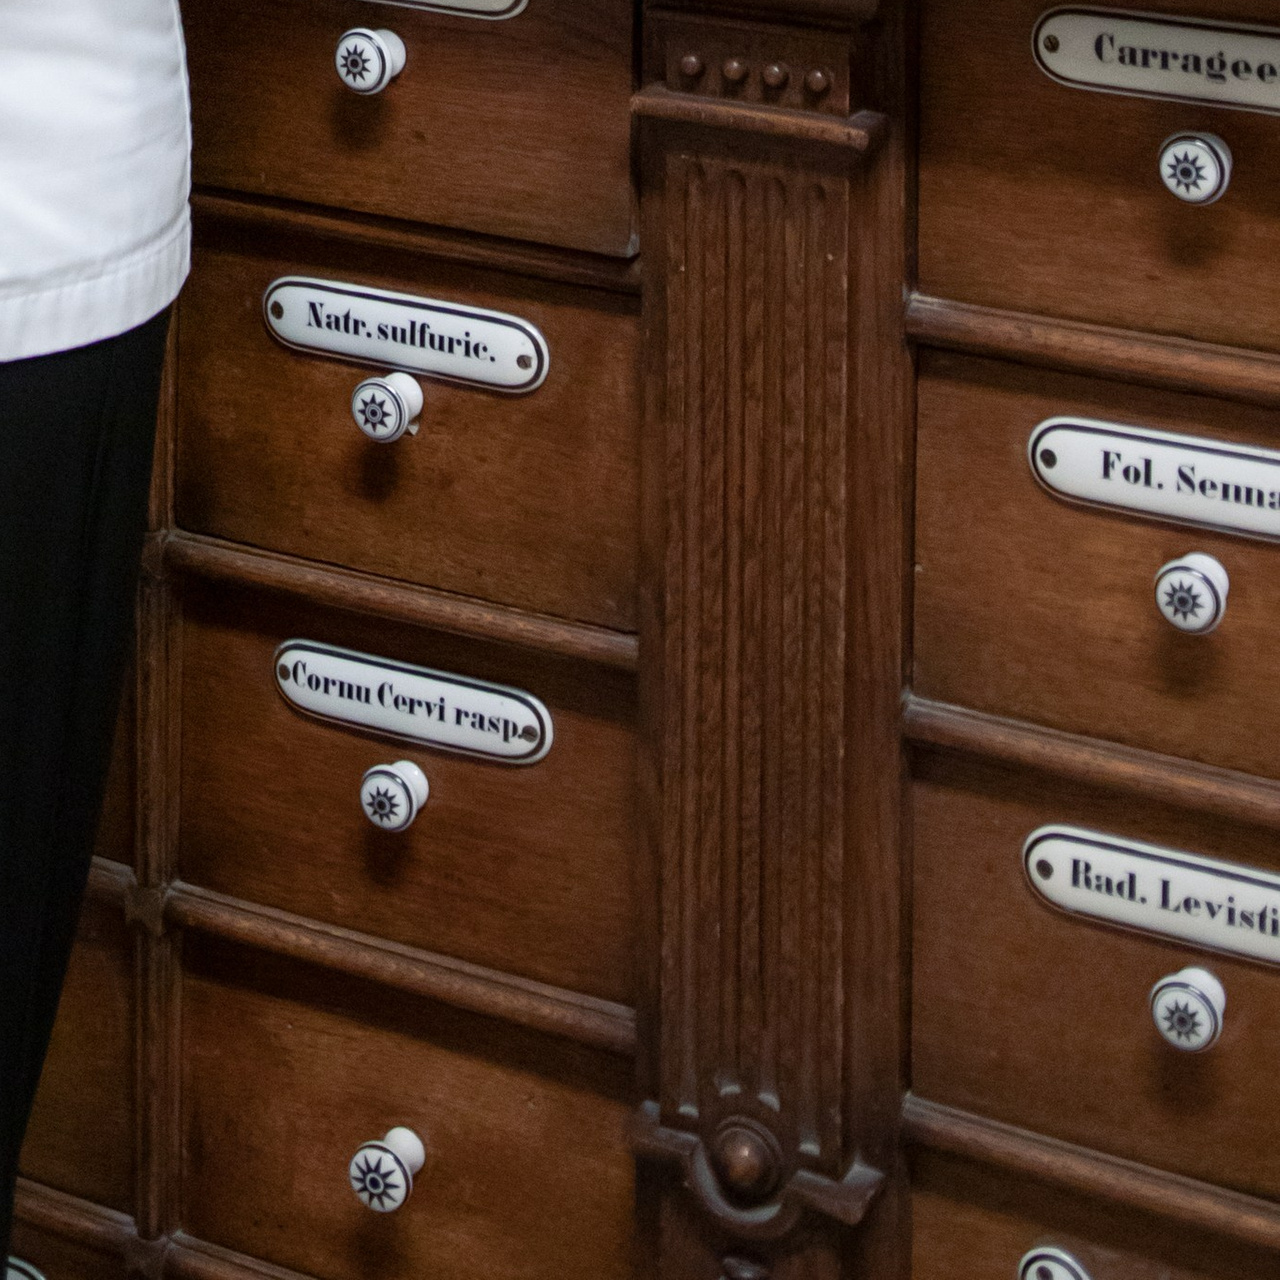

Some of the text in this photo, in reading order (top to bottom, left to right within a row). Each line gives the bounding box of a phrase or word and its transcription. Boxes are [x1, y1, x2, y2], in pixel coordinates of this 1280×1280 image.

[305, 300, 497, 364] Natr. sulfuric.
[1100, 449, 1164, 491] Fol.
[291, 659, 525, 744] Cornu Cervi rasp.
[1069, 857, 1148, 906] Rad.
